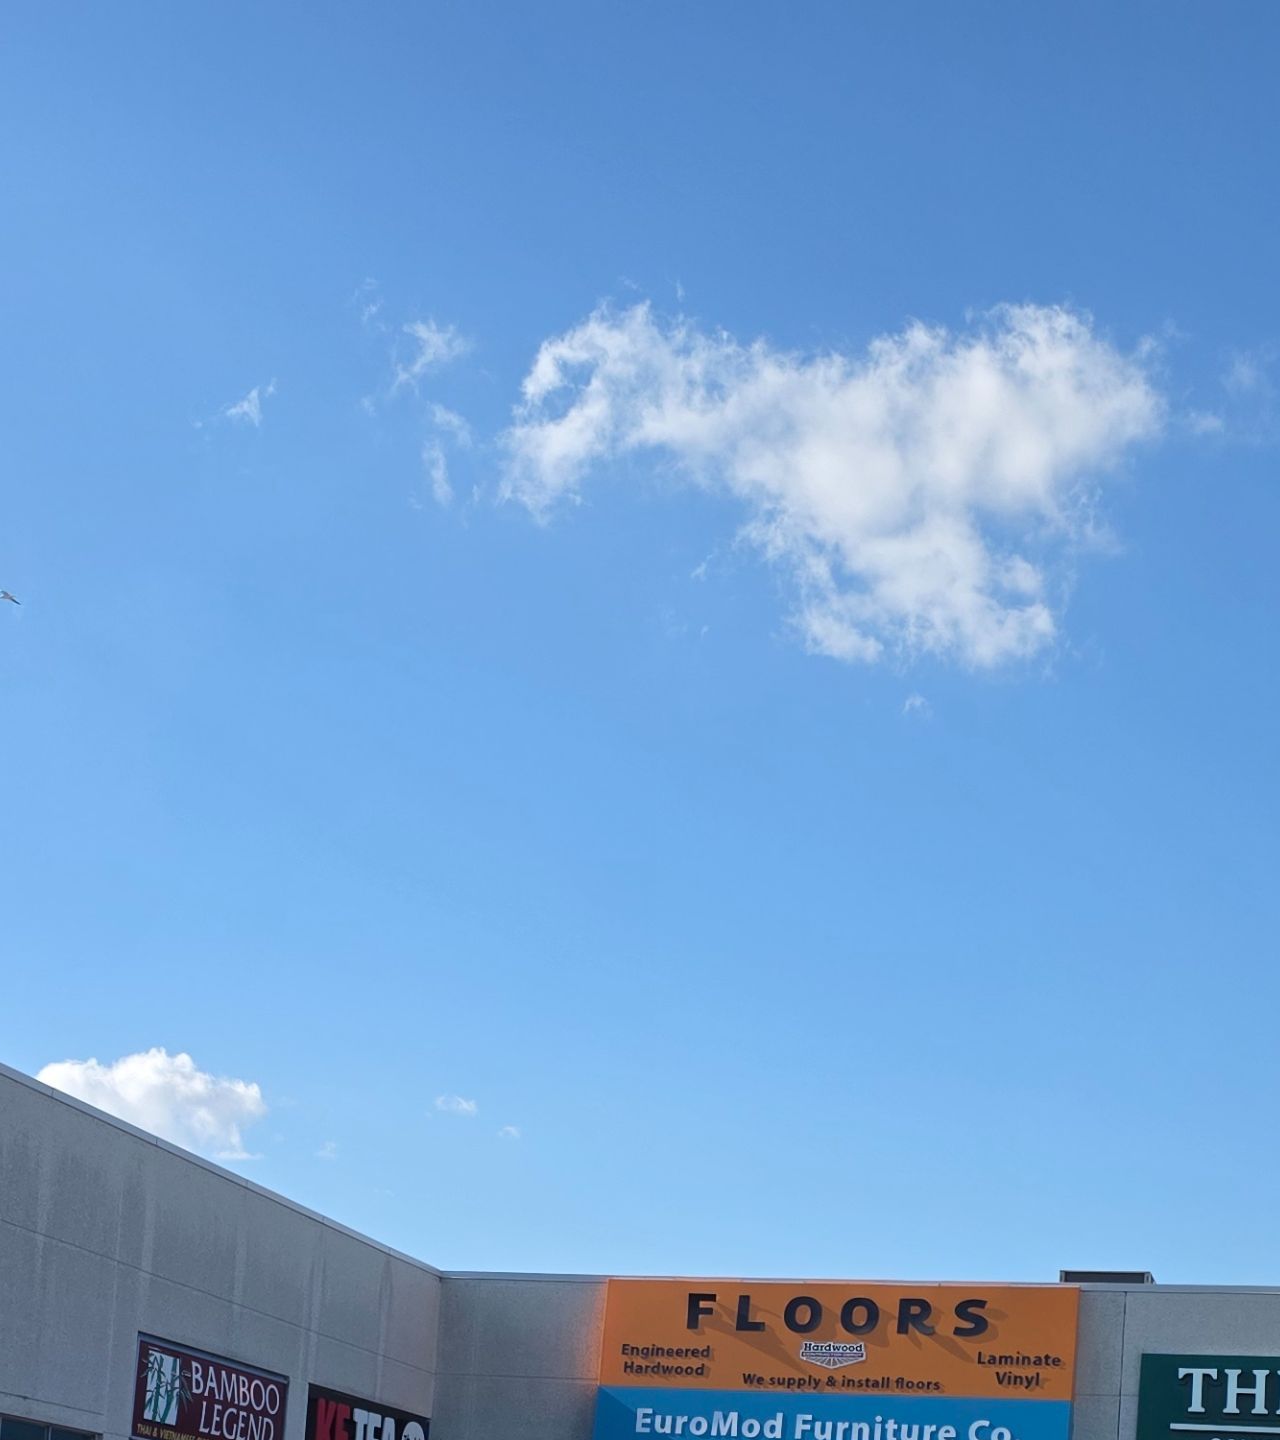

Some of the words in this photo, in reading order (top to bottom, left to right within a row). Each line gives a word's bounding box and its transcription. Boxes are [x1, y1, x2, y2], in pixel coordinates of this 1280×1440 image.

[687, 1293, 989, 1338] FLOORS
[621, 1344, 710, 1360] Engineered
[804, 1343, 863, 1352] Hardwood
[624, 1361, 705, 1376] Hardwood
[977, 1352, 1062, 1368] Laminate
[191, 1361, 280, 1415] BAMBOO
[743, 1374, 764, 1386] We
[769, 1375, 821, 1390] supply
[825, 1376, 836, 1387] &
[841, 1376, 890, 1389] install
[895, 1377, 940, 1391] floors
[995, 1370, 1040, 1389] Vinyl
[636, 1408, 783, 1440] EuroMod
